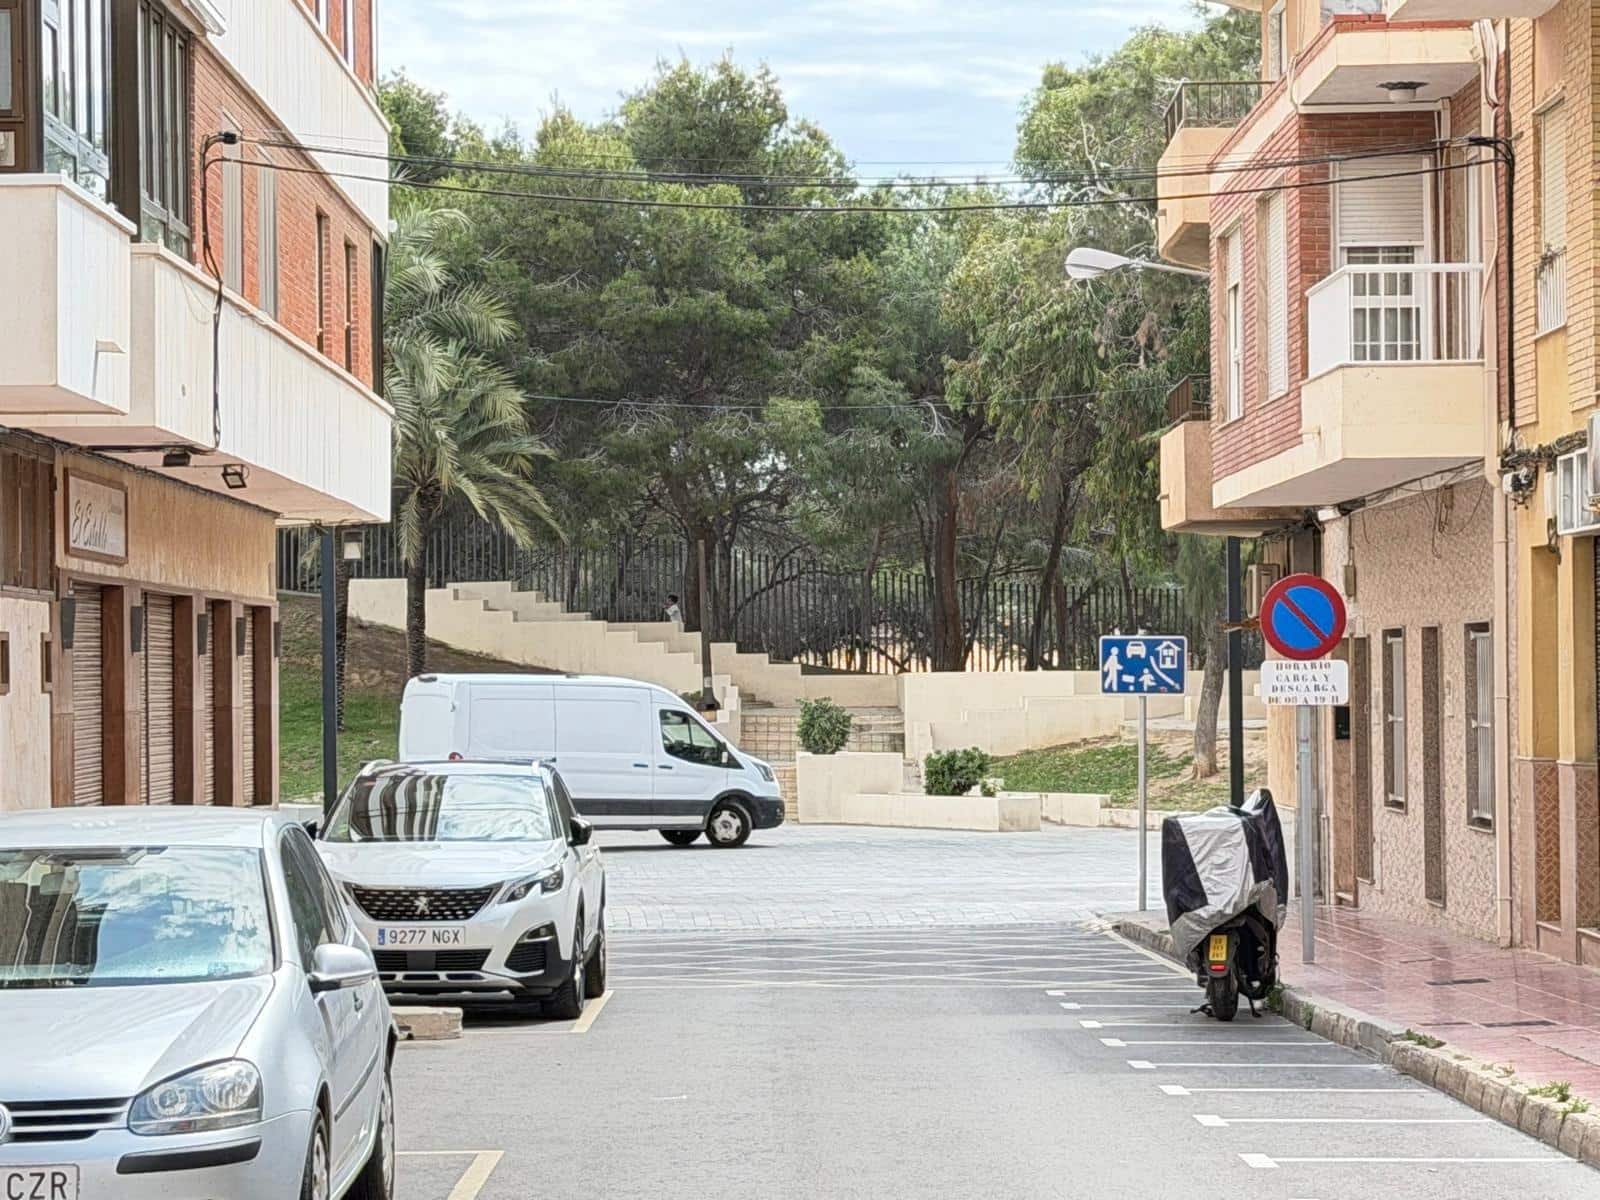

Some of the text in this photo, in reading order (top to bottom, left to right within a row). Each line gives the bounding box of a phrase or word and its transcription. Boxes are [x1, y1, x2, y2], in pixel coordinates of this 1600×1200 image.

[1275, 662, 1331, 671] HORARIO
[1275, 674, 1330, 682] CARGA Y
[1271, 684, 1337, 693] DESCARGA
[1268, 696, 1281, 704] DE
[389, 929, 426, 945] 9277
[432, 929, 460, 944] NGX
[7, 1171, 68, 1200] CZR
